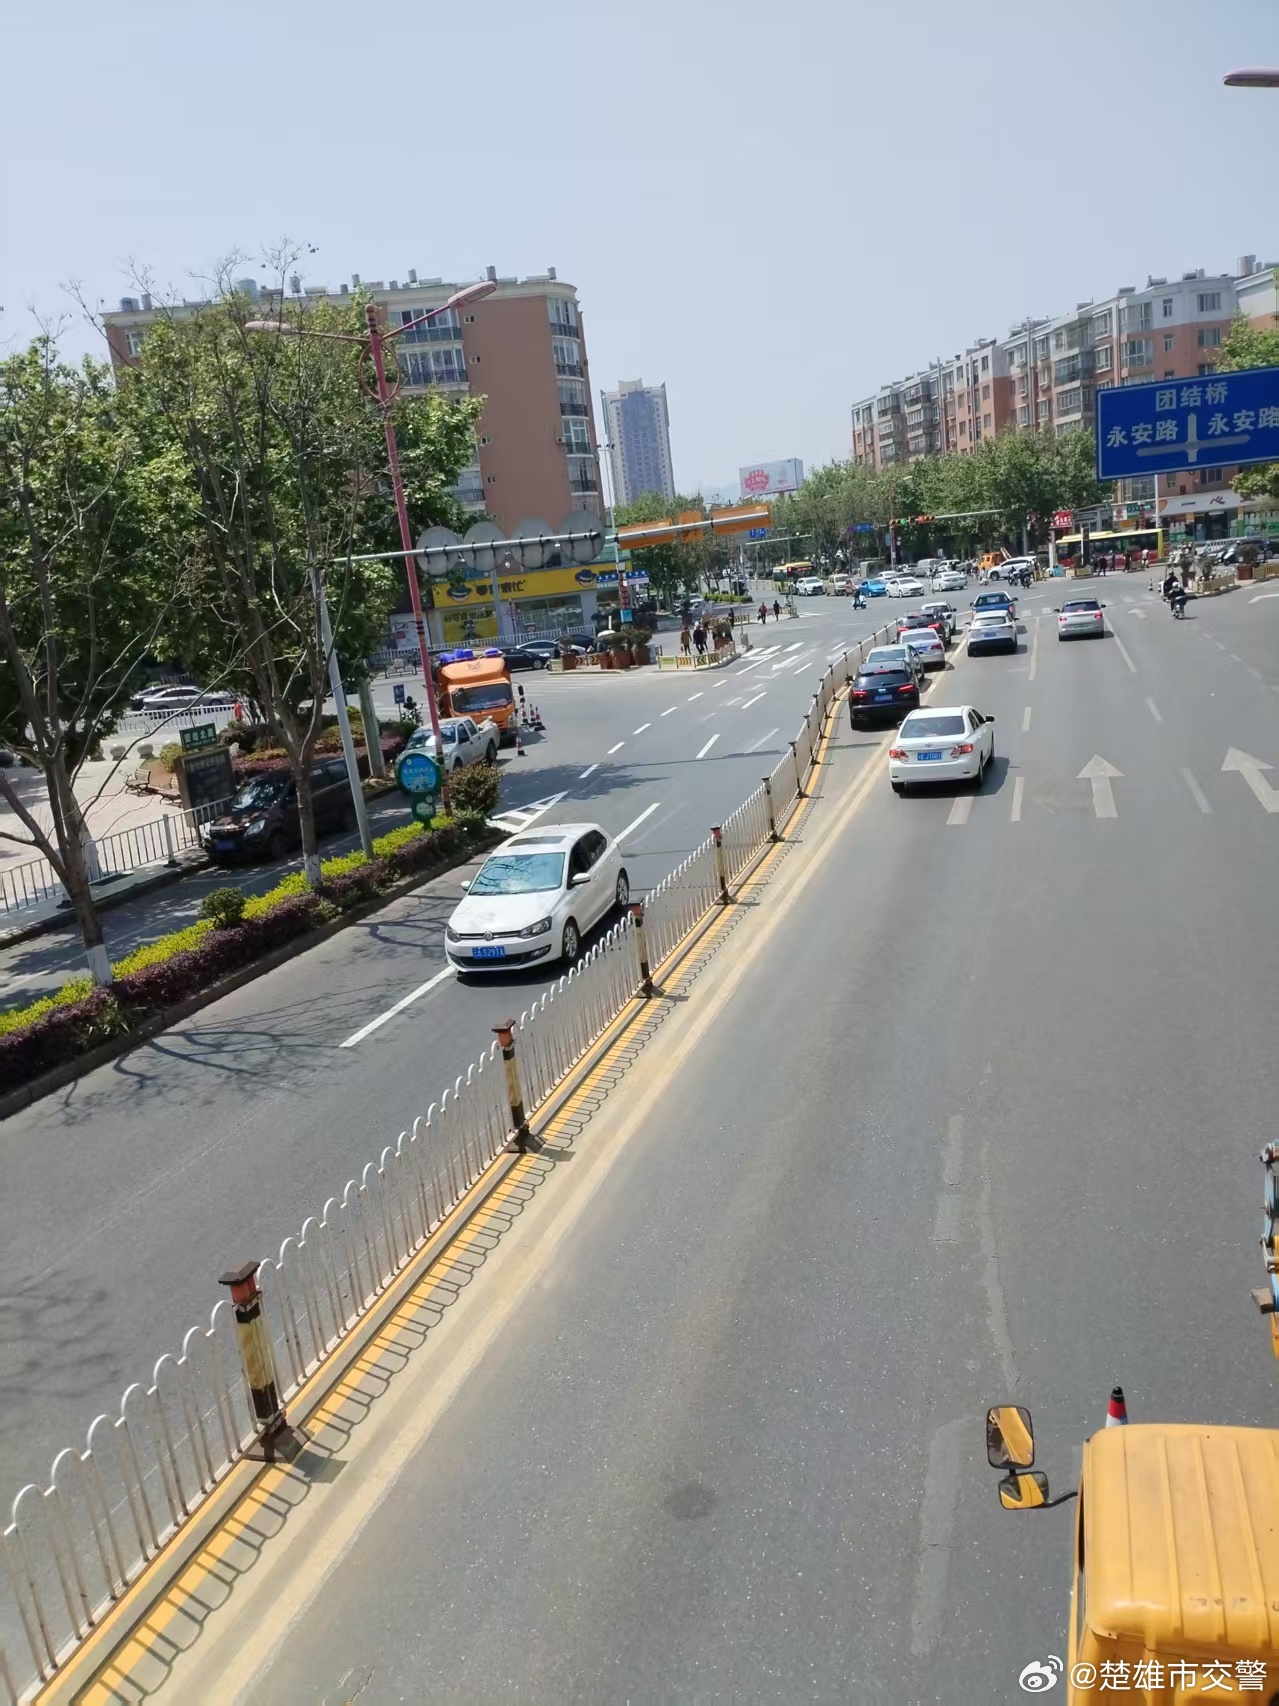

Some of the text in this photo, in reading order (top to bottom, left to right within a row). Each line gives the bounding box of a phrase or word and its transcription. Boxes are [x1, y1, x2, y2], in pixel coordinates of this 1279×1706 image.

[1155, 382, 1229, 412] 团结桥
[1106, 419, 1179, 448] 永安路
[1207, 406, 1279, 436] 永安路
